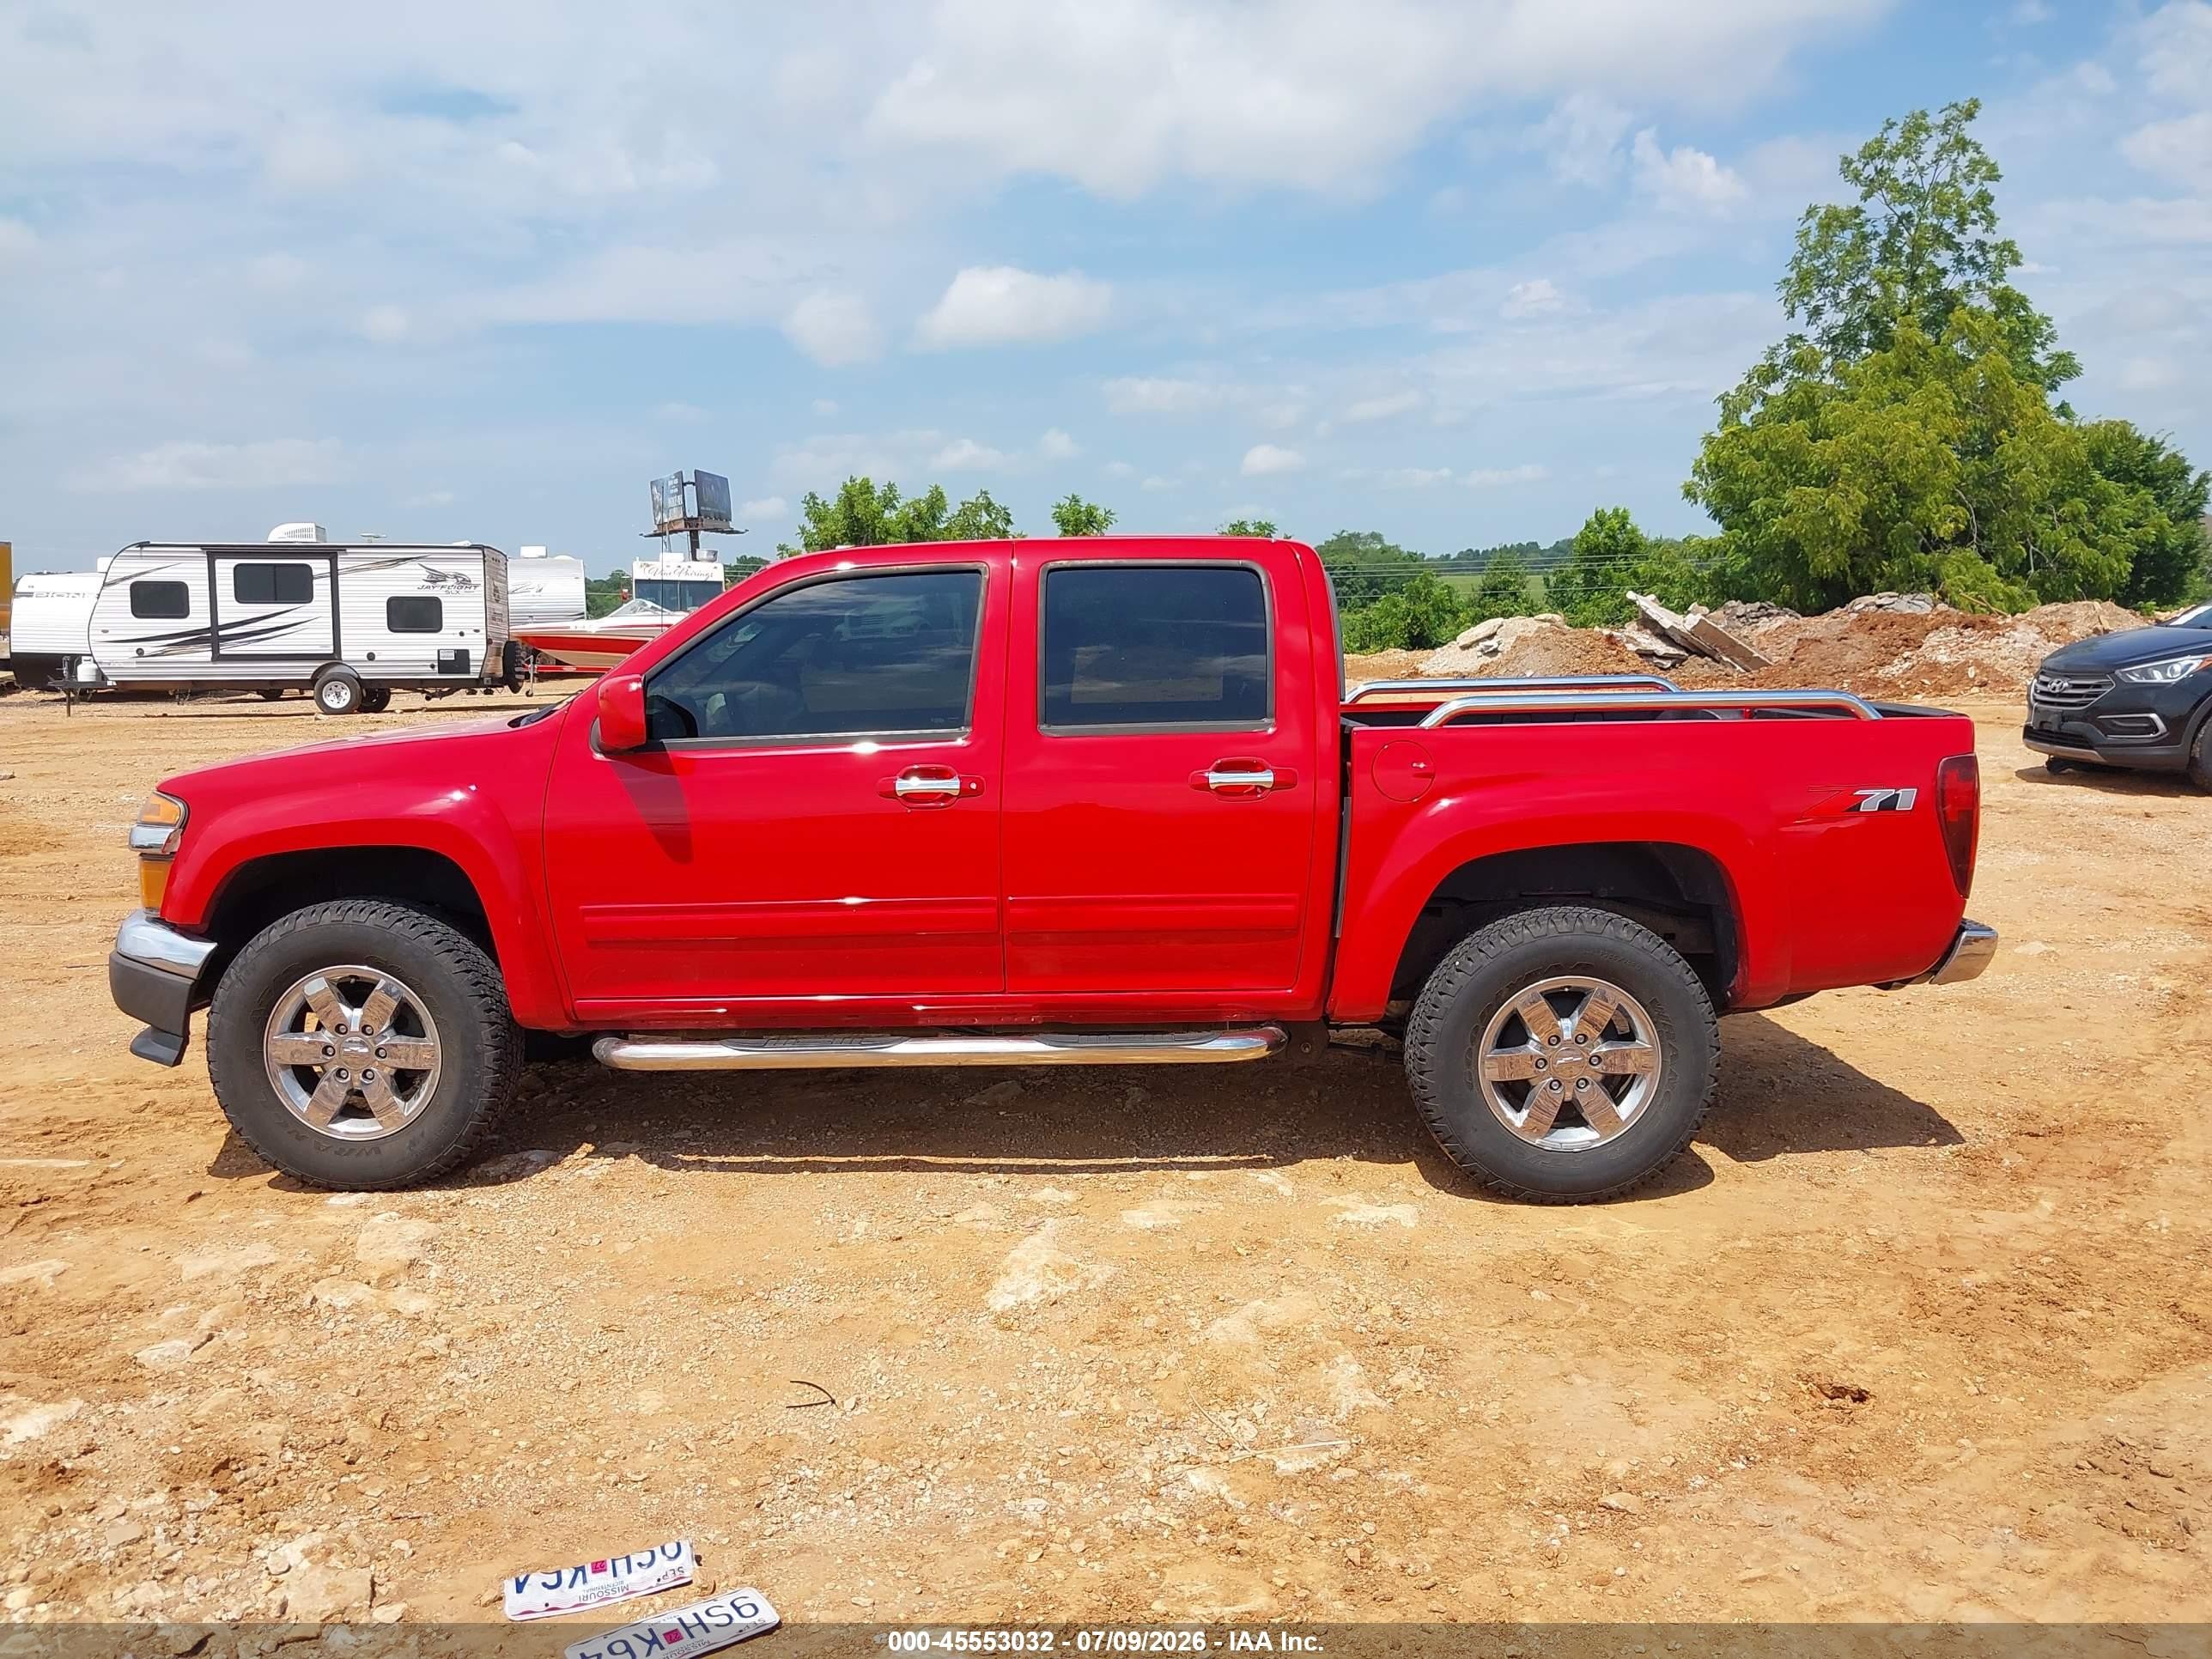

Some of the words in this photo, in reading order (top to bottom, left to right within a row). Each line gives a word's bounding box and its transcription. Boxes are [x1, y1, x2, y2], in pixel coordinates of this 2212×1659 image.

[662, 1566, 686, 1580] SEP
[579, 1583, 629, 1602] MISSOURI
[677, 1595, 760, 1638] 9SH
